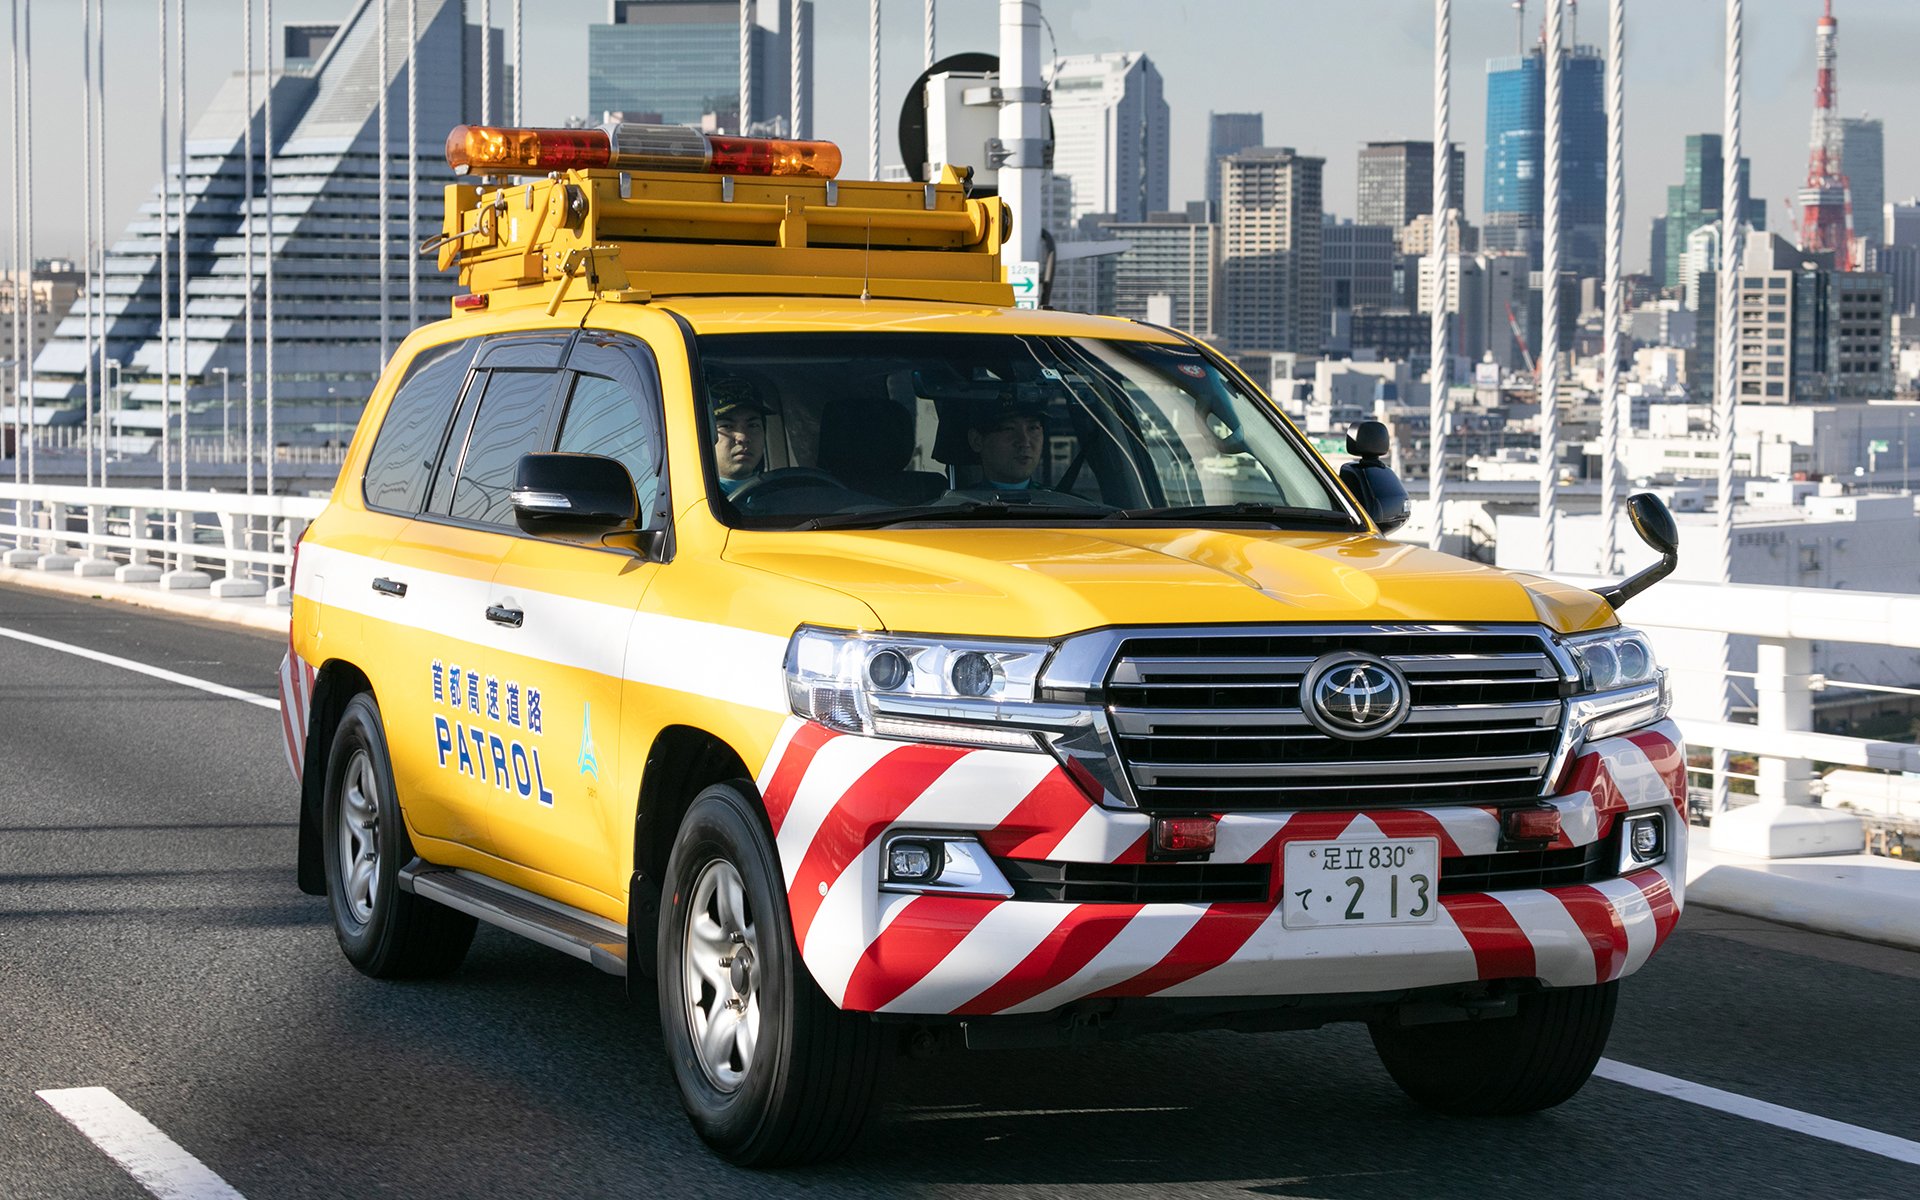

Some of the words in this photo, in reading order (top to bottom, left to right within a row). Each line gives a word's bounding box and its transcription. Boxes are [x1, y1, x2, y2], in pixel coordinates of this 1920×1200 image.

[1011, 265, 1036, 275] 120m
[432, 659, 543, 735] 首都高速道路
[434, 715, 554, 807] PATROL
[1322, 847, 1364, 870] 足立
[1368, 846, 1406, 868] 830
[1294, 888, 1313, 911] て
